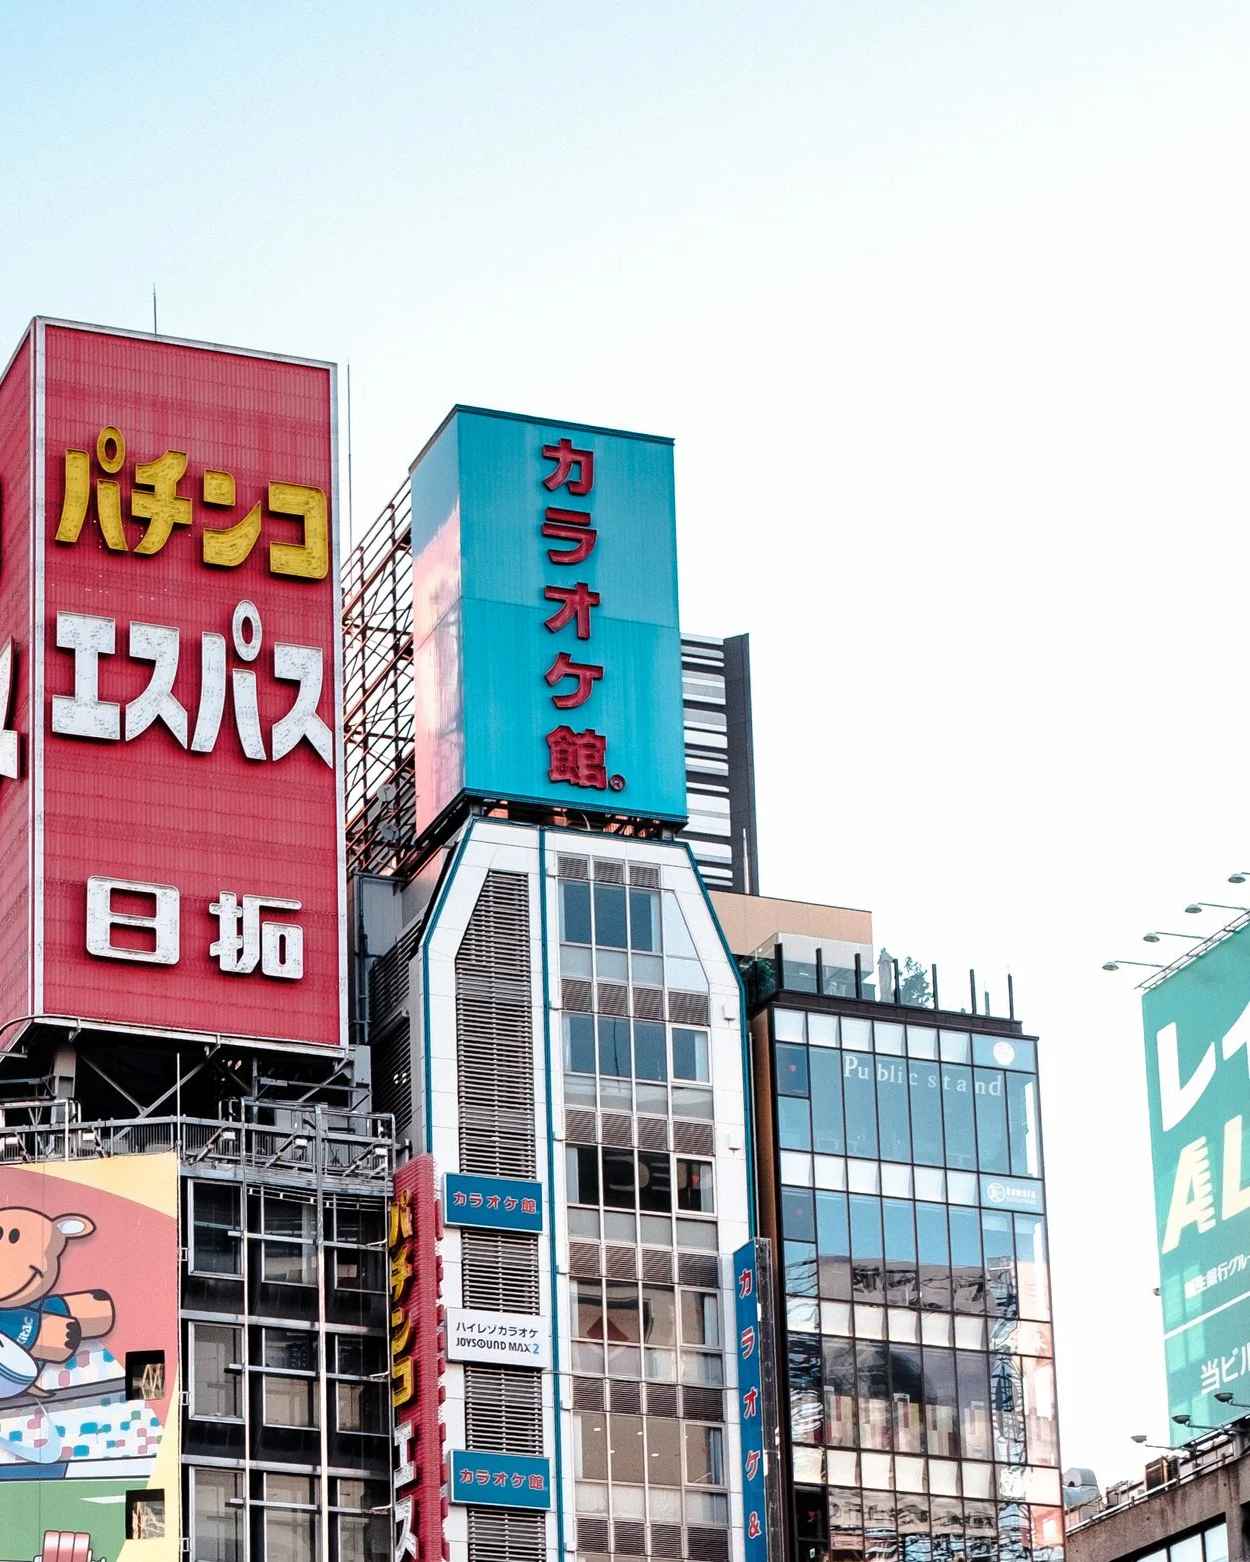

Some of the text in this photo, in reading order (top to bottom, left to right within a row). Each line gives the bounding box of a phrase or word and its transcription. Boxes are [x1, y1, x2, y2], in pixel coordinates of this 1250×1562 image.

[55, 426, 330, 580] パチンコ
[541, 438, 608, 791] カラオケ館
[52, 600, 334, 769] エスパス
[86, 876, 304, 979] 日拓
[844, 1055, 1002, 1097] Public stand
[453, 1190, 538, 1215] カラオケ館
[389, 1188, 414, 1409] パチンコ
[455, 1321, 539, 1338] ハイレゾカラオケ
[456, 1336, 507, 1351] JOYSOUND
[459, 1469, 544, 1491] カラオケ館
